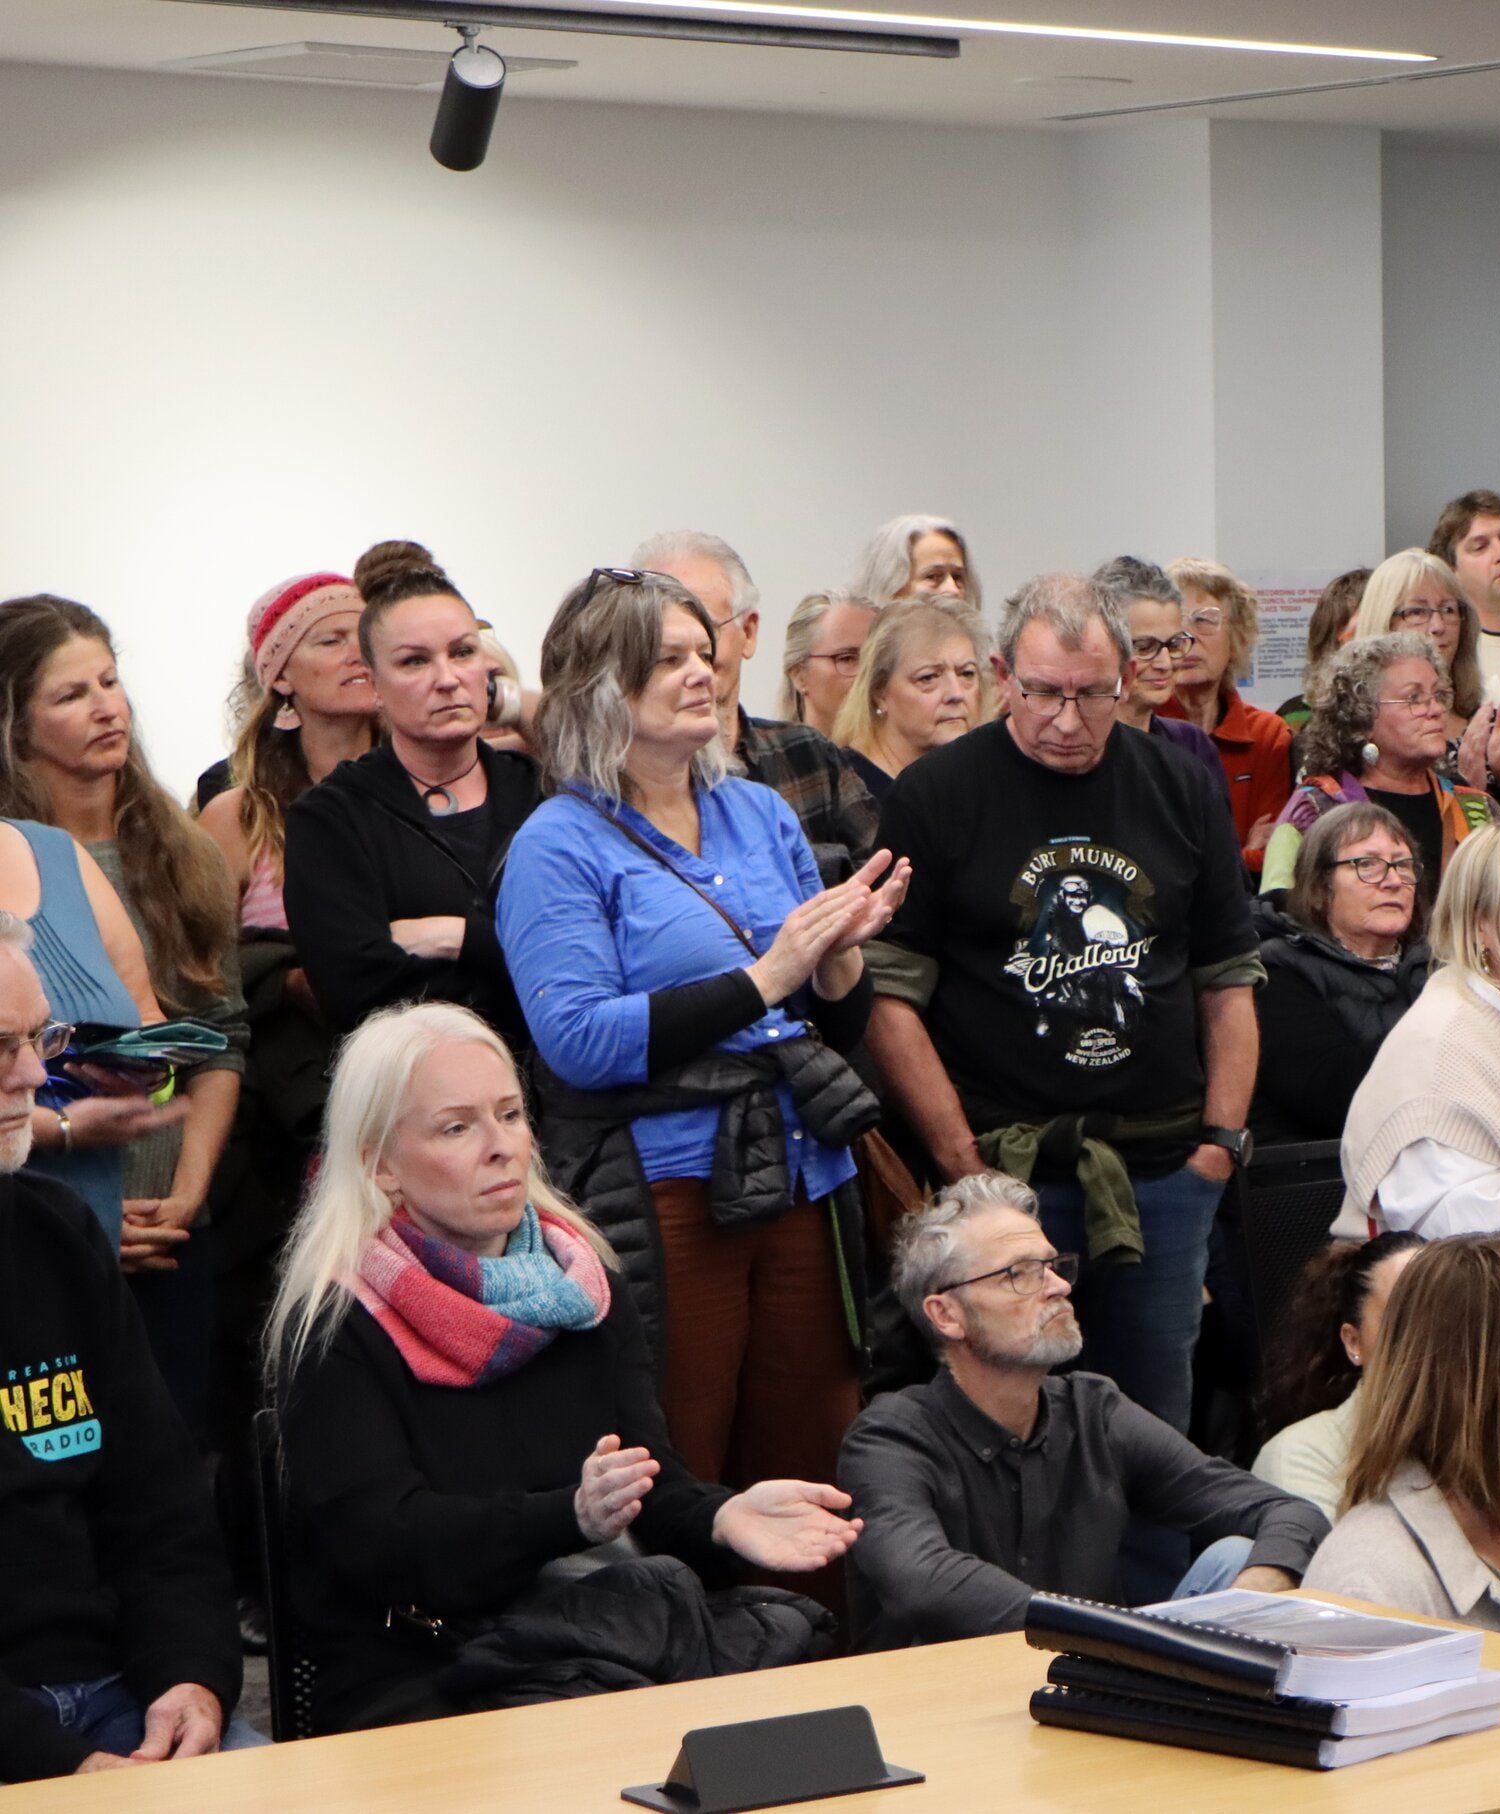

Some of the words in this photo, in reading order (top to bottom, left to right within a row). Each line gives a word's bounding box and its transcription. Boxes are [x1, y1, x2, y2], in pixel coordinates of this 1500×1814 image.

[1021, 851, 1057, 885] BURT
[1069, 847, 1138, 882] MUNRO
[1064, 1052, 1088, 1066] NEW
[1088, 1048, 1132, 1067] ZEALAND
[30, 1427, 95, 1454] RADIO
